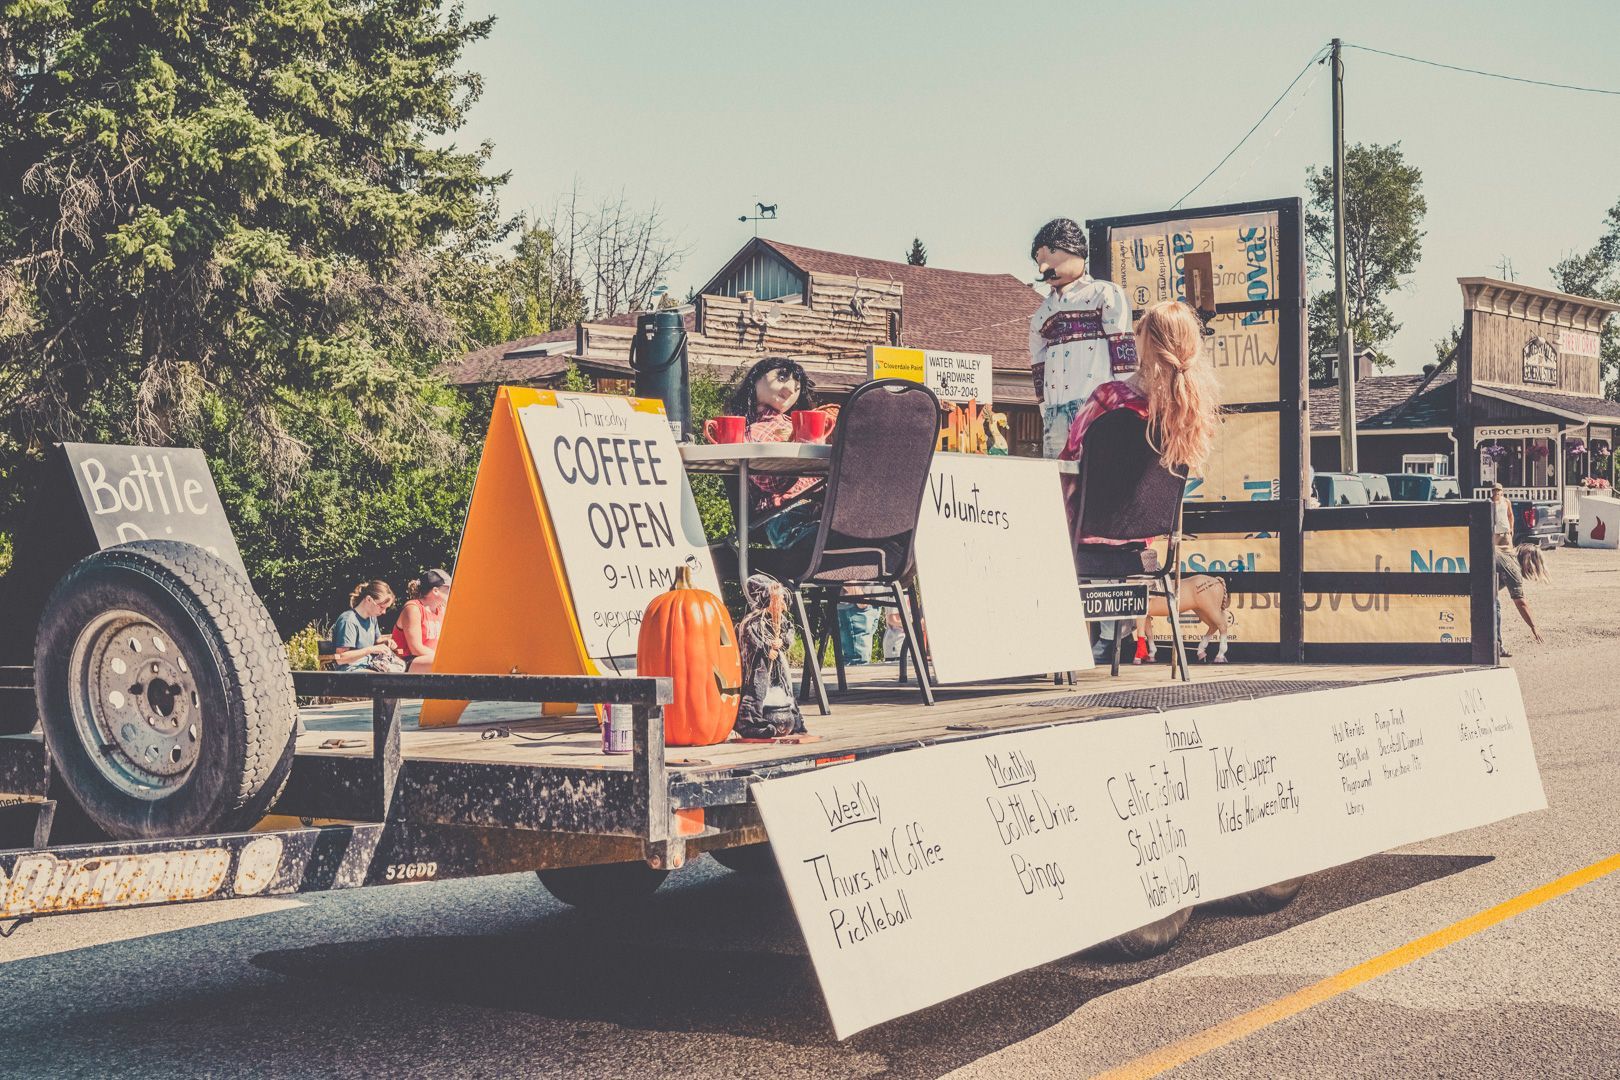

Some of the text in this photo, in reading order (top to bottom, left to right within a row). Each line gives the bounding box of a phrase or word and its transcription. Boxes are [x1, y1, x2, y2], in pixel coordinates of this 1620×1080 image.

[884, 362, 910, 371] Cloverdale
[929, 356, 981, 370] WATER VALLEY
[936, 371, 975, 384] HARDWARE
[563, 397, 628, 430] Thursday
[1480, 427, 1551, 436] GROCERIES
[553, 435, 668, 486] COFFEE
[80, 454, 208, 515] Bottle
[929, 472, 1010, 529] Volunteers
[587, 501, 676, 550] OPEN
[603, 564, 673, 589] 9-11 AM
[1086, 591, 1112, 599] LOOKING
[1105, 597, 1145, 613] MUFFIN
[1164, 718, 1203, 748] Annual
[985, 749, 1037, 785] Monthly
[1106, 772, 1154, 820] Celtic
[1217, 799, 1243, 835] Kids
[1276, 780, 1300, 814] Party
[986, 789, 1079, 846] Bottle Drive
[891, 820, 944, 876] Coffee
[1010, 852, 1066, 901] Bingo
[1177, 855, 1200, 899] Day
